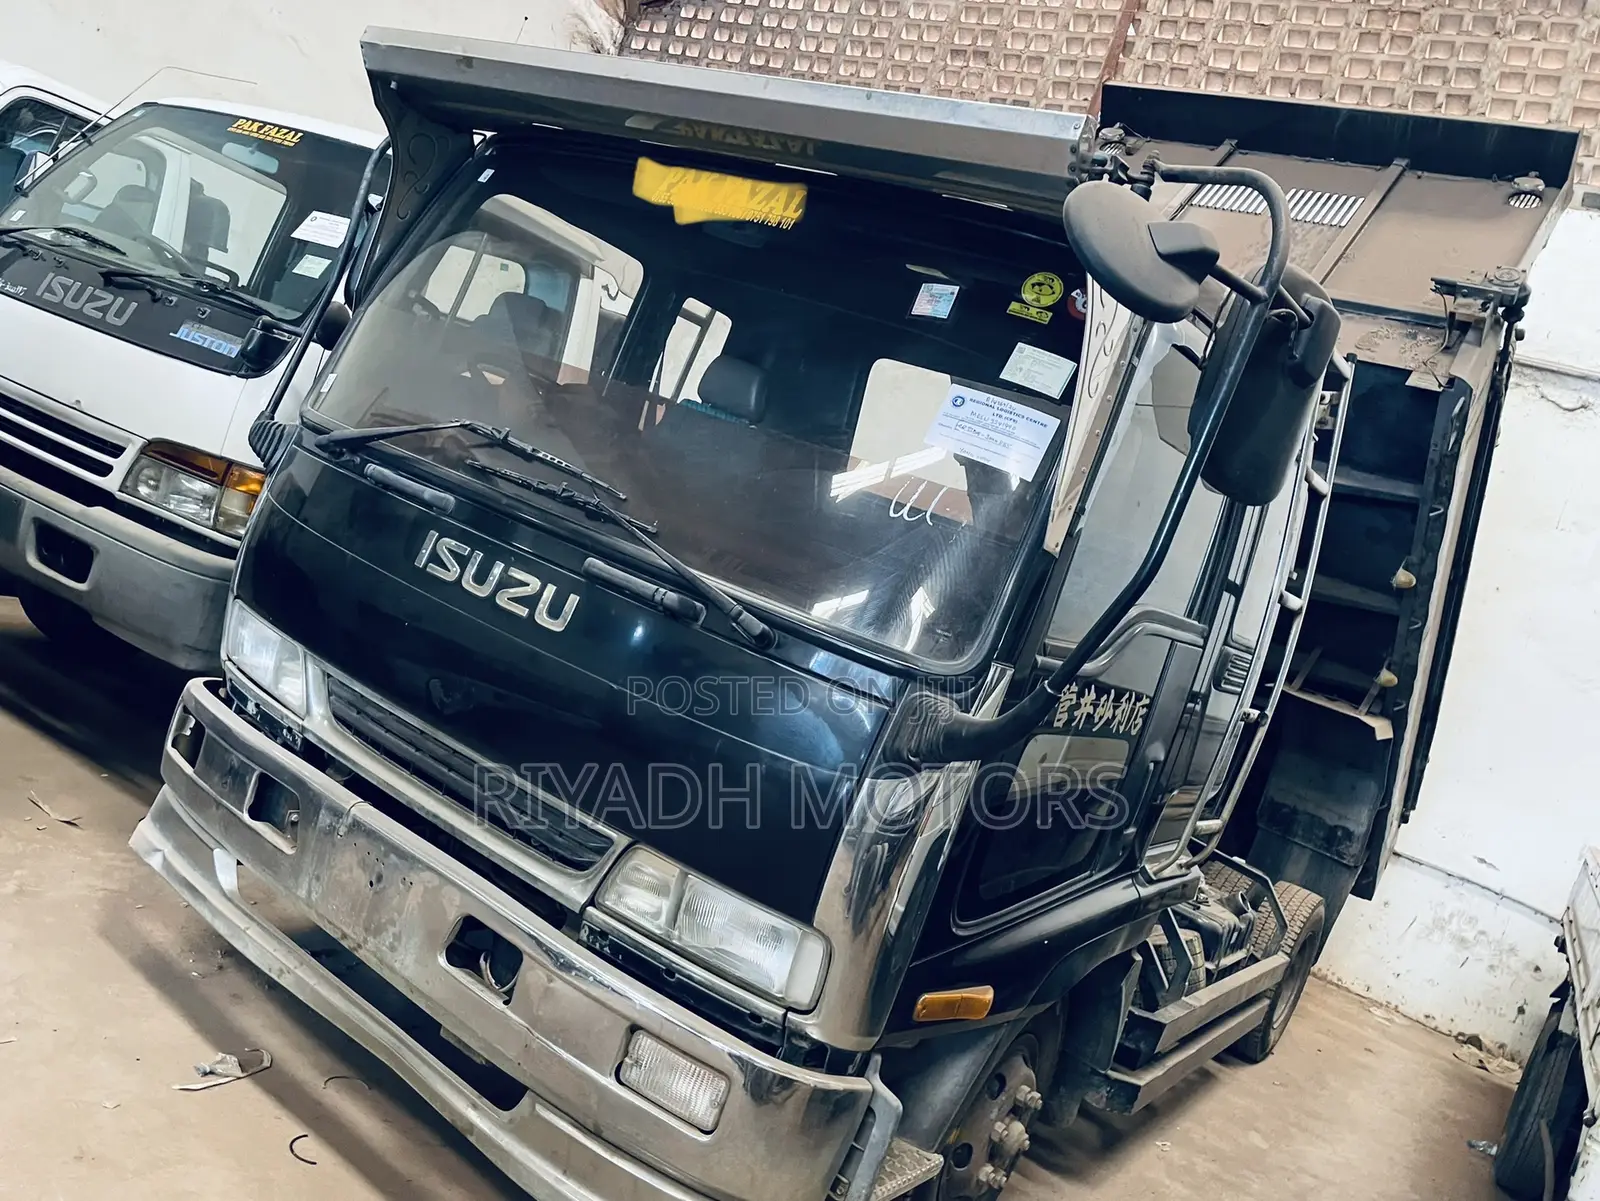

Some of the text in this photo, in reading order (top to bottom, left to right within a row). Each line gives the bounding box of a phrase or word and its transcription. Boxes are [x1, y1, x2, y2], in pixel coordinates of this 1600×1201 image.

[232, 118, 264, 133] PAK
[259, 124, 304, 144] FAZAL
[36, 272, 138, 327] ISUZU
[968, 396, 1048, 429] REGIONAL LOGISTICS CENTRE
[414, 530, 580, 632] ISUZU
